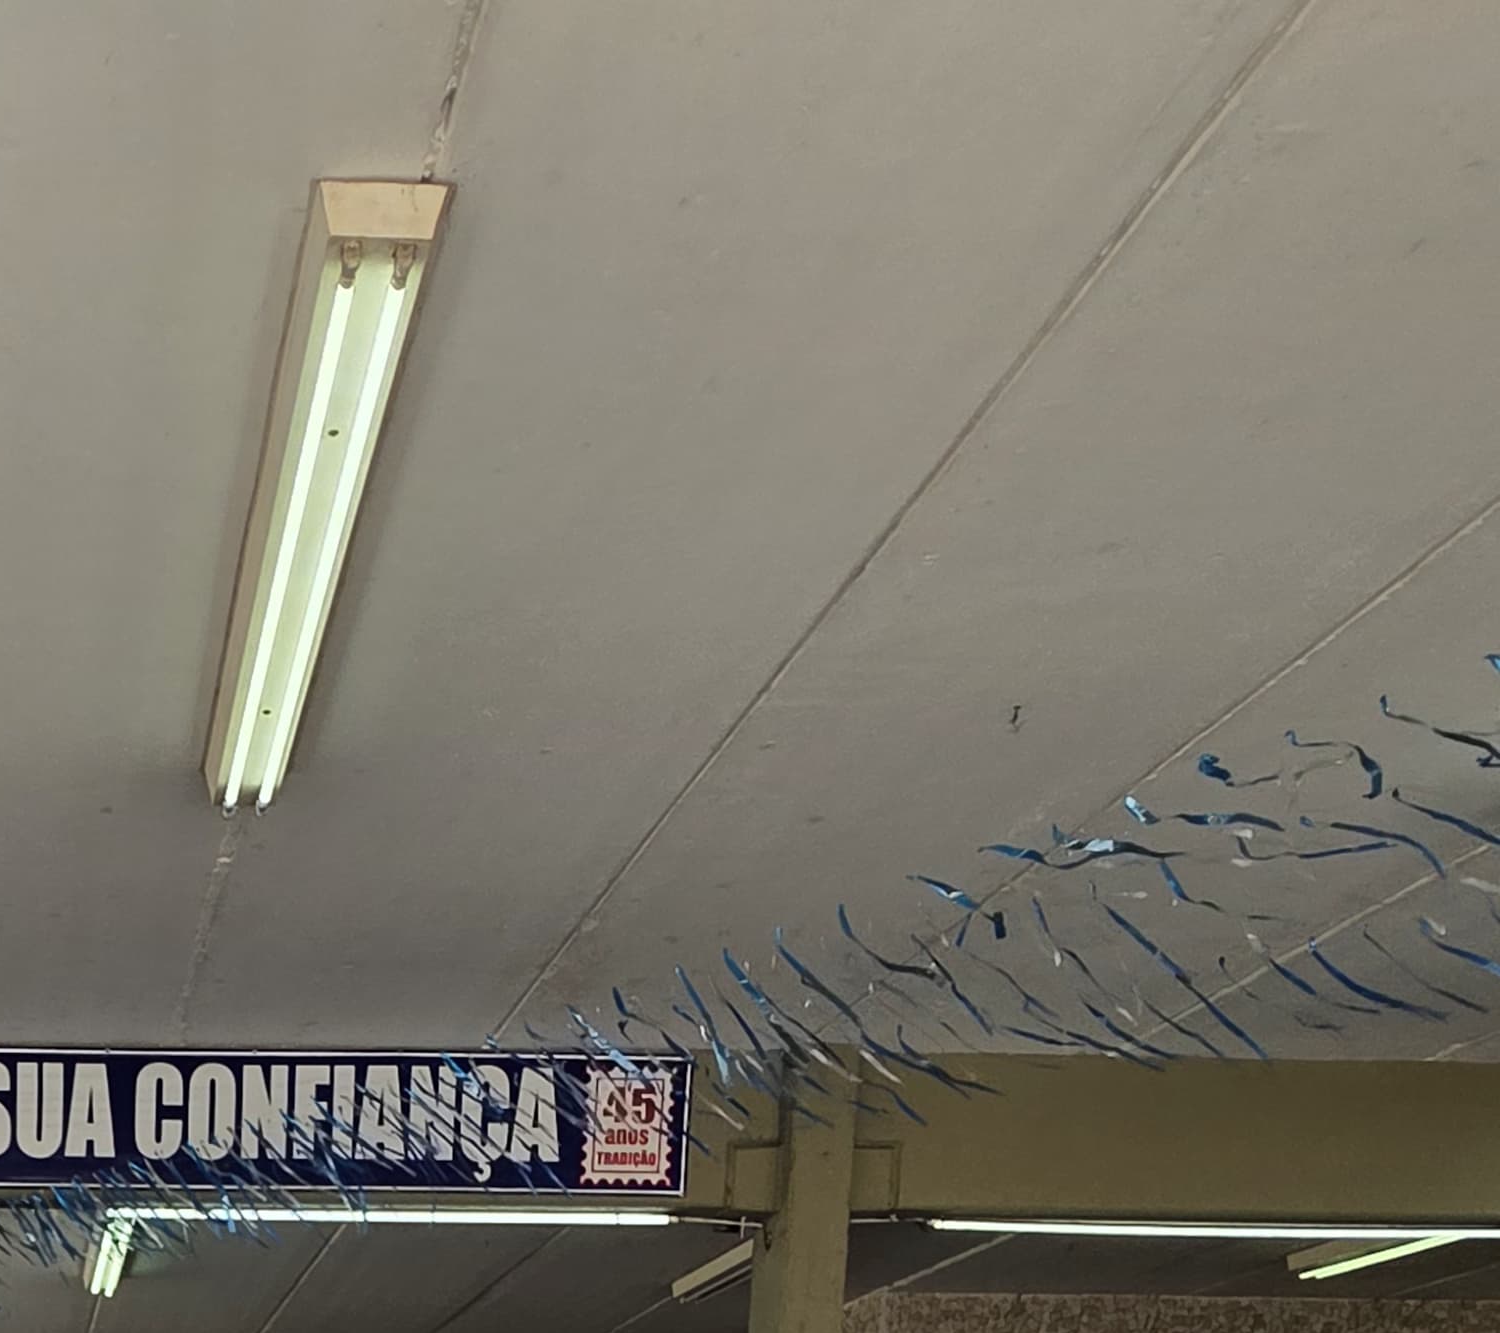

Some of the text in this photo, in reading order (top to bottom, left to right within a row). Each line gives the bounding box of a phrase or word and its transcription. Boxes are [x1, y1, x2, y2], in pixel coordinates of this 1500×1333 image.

[602, 1085, 658, 1124] 45
[134, 1062, 560, 1181] CONFIANÇA
[604, 1128, 649, 1145] anos
[597, 1150, 657, 1168] TRADIÇÃO
